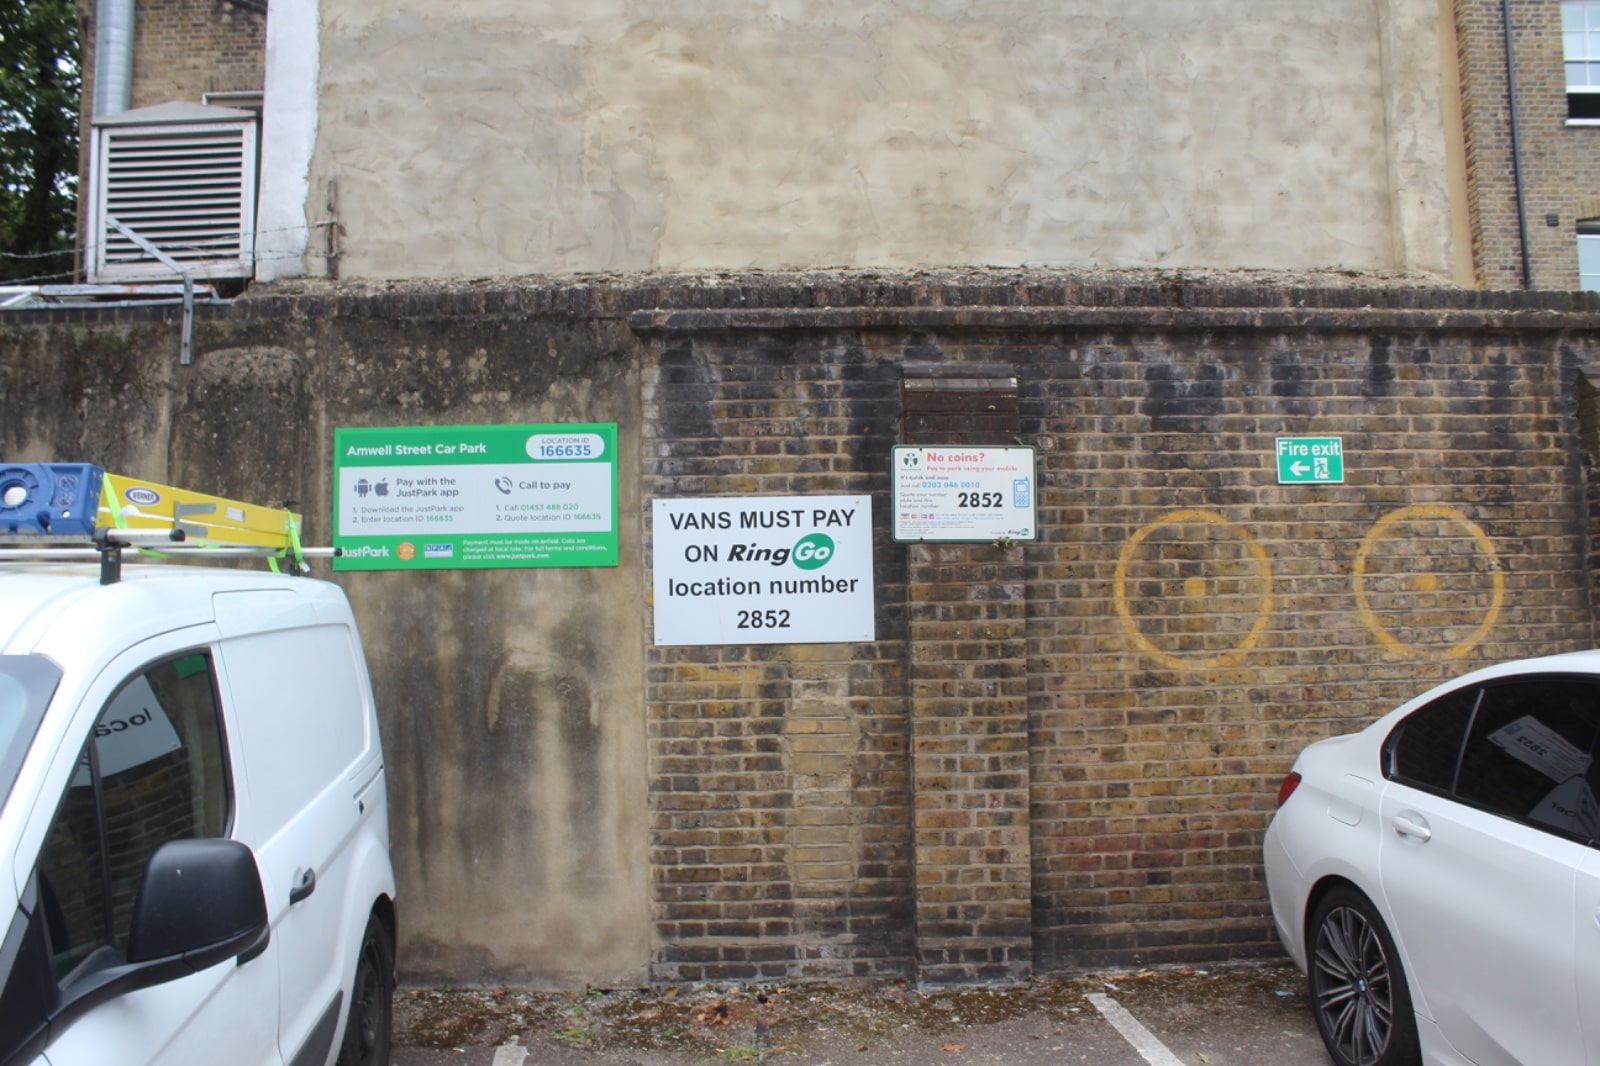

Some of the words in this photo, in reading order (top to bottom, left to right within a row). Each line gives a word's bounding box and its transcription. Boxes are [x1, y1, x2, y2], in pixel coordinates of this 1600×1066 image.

[347, 444, 392, 456] Amwell
[395, 444, 432, 455] Street
[435, 443, 456, 454] Car
[460, 442, 487, 454] Park
[540, 445, 591, 456] 166635
[1279, 441, 1308, 456] Fire
[1311, 440, 1340, 456] exit
[926, 452, 944, 462] No
[948, 452, 985, 462] coins?
[396, 478, 414, 488] Pay
[416, 477, 438, 486] with
[440, 477, 456, 486] the
[519, 481, 538, 489] Call
[553, 482, 571, 490] pay
[132, 490, 154, 500] WERNER
[396, 488, 438, 497] JustPark
[440, 489, 459, 498] app
[958, 492, 1003, 508] 2852
[496, 514, 502, 522] 2.
[504, 514, 528, 522] Quote
[530, 513, 560, 521] location
[670, 511, 732, 530] VANS
[740, 510, 805, 528] MUST
[812, 509, 856, 527] PAY
[684, 544, 718, 563] ON
[728, 542, 831, 566] RingGo
[669, 577, 760, 596] location
[770, 575, 858, 594] number
[737, 610, 791, 629] 2852
